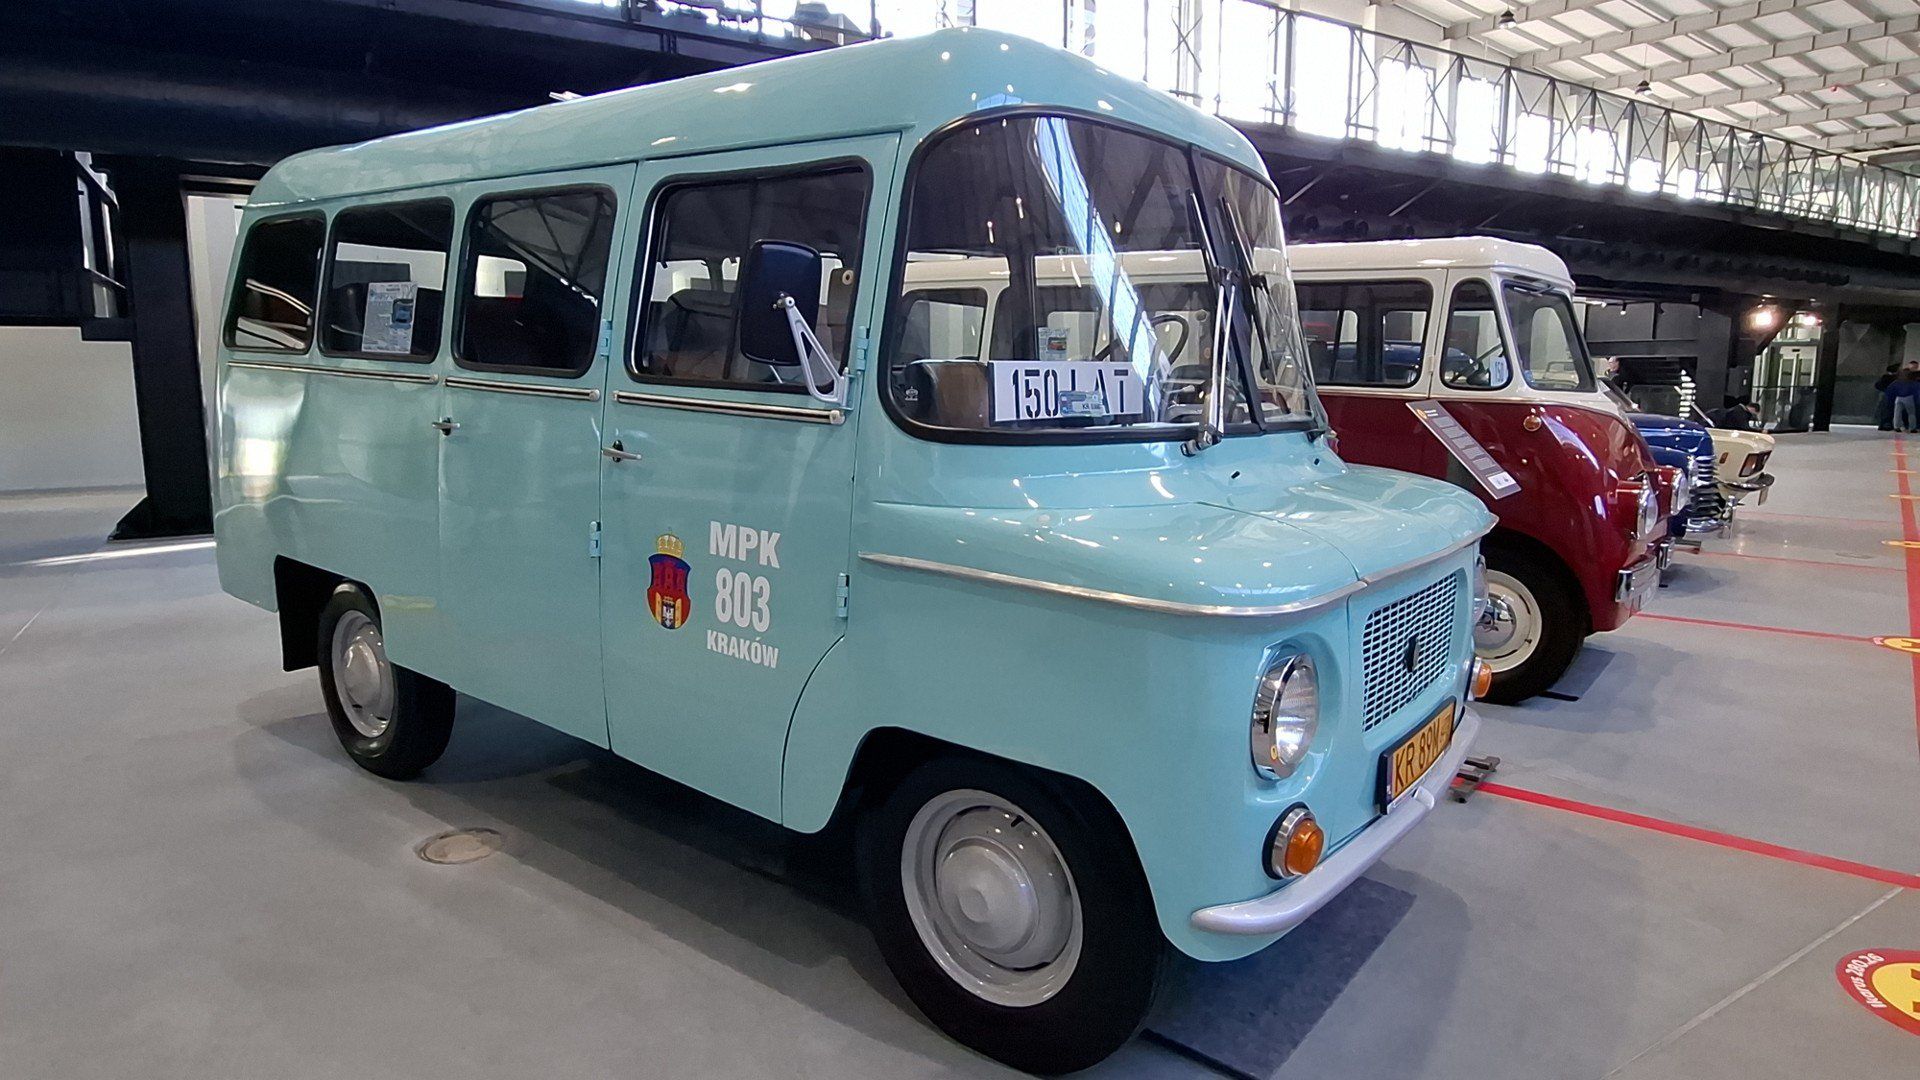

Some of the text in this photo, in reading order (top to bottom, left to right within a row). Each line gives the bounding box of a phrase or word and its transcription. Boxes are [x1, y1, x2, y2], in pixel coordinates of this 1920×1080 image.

[1012, 369, 1059, 419] 150
[709, 520, 781, 569] MPK
[715, 567, 771, 633] 803
[706, 629, 779, 669] KRAKÓW
[1395, 741, 1415, 794] KR
